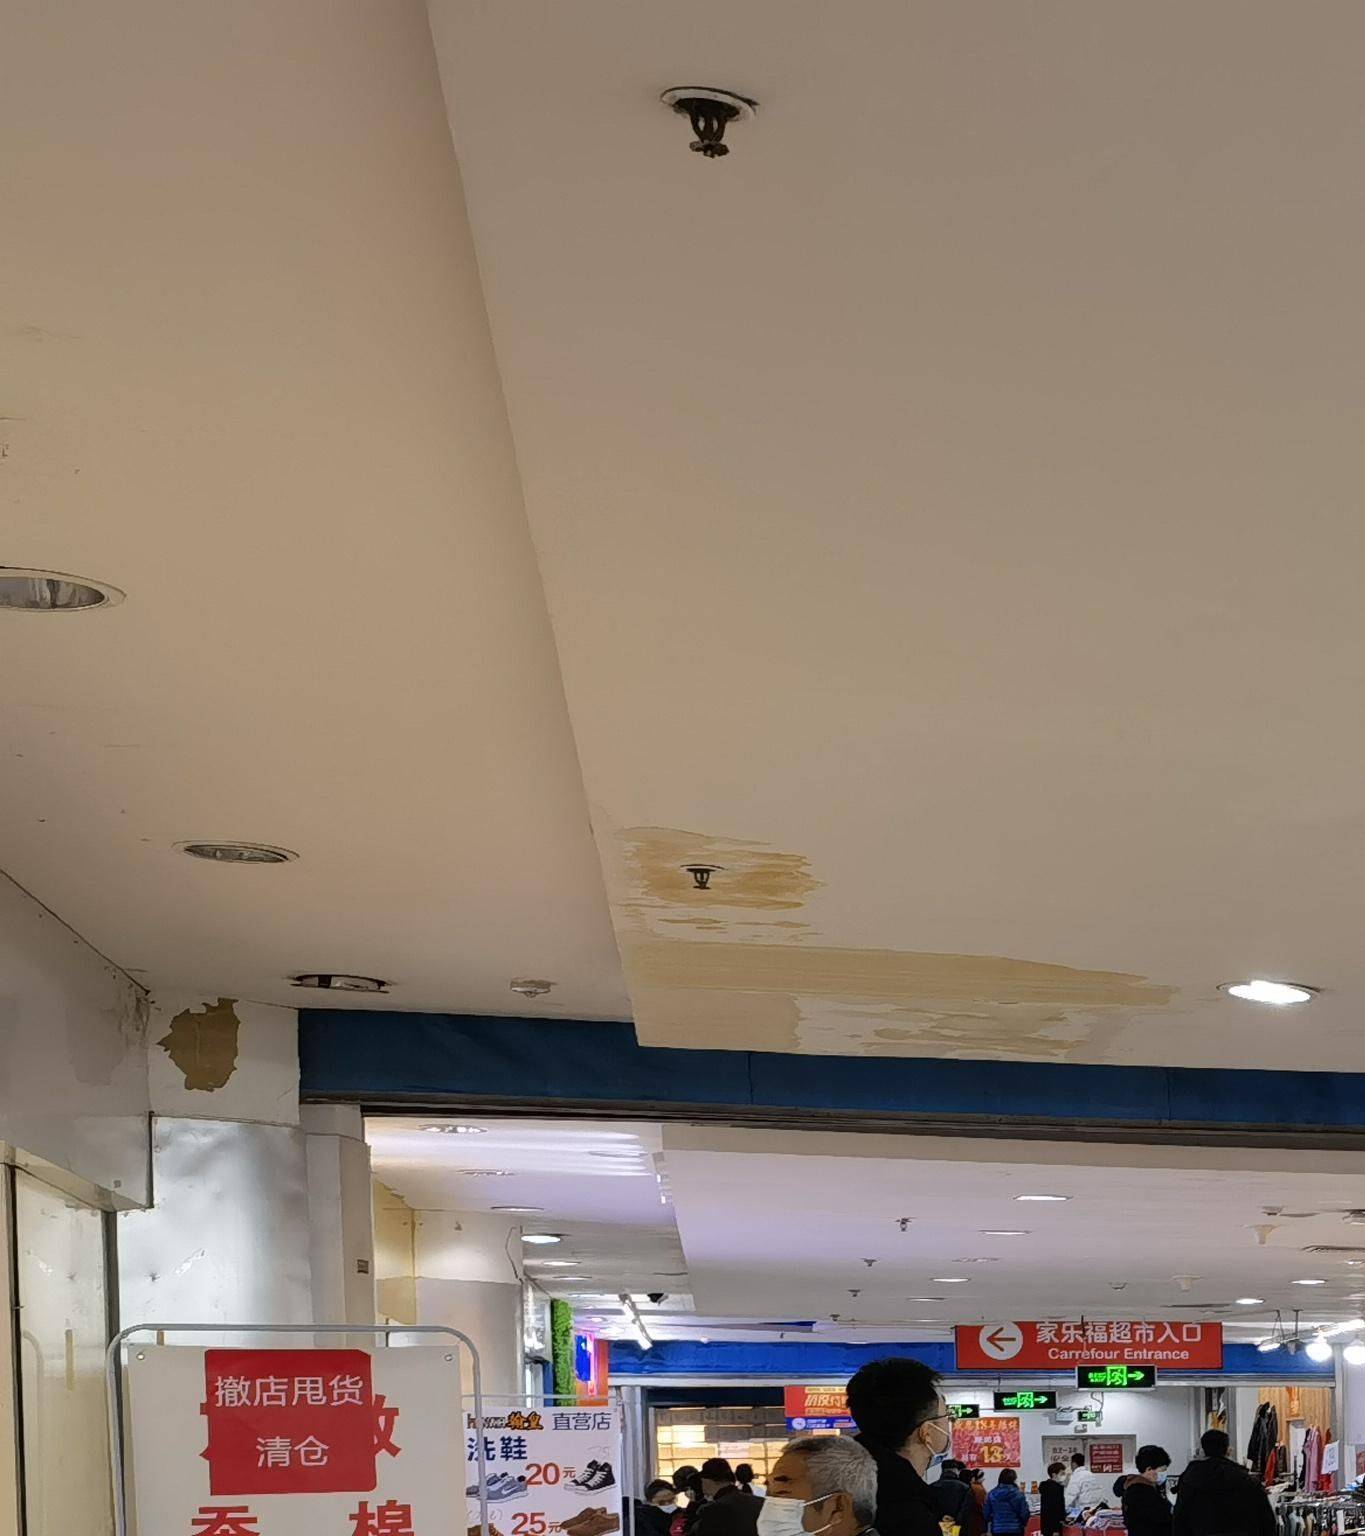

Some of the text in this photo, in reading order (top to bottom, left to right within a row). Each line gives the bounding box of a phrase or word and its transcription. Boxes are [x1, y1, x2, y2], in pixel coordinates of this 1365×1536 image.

[1036, 1321, 1202, 1345] 家乐福超市入口
[1048, 1347, 1190, 1361] Carrefour Entrance
[214, 1374, 364, 1407] 撤店甩货
[551, 1411, 612, 1431] 直营店
[255, 1434, 329, 1468] 清仓
[525, 1462, 576, 1486] 20元
[511, 1512, 562, 1535] 25元
